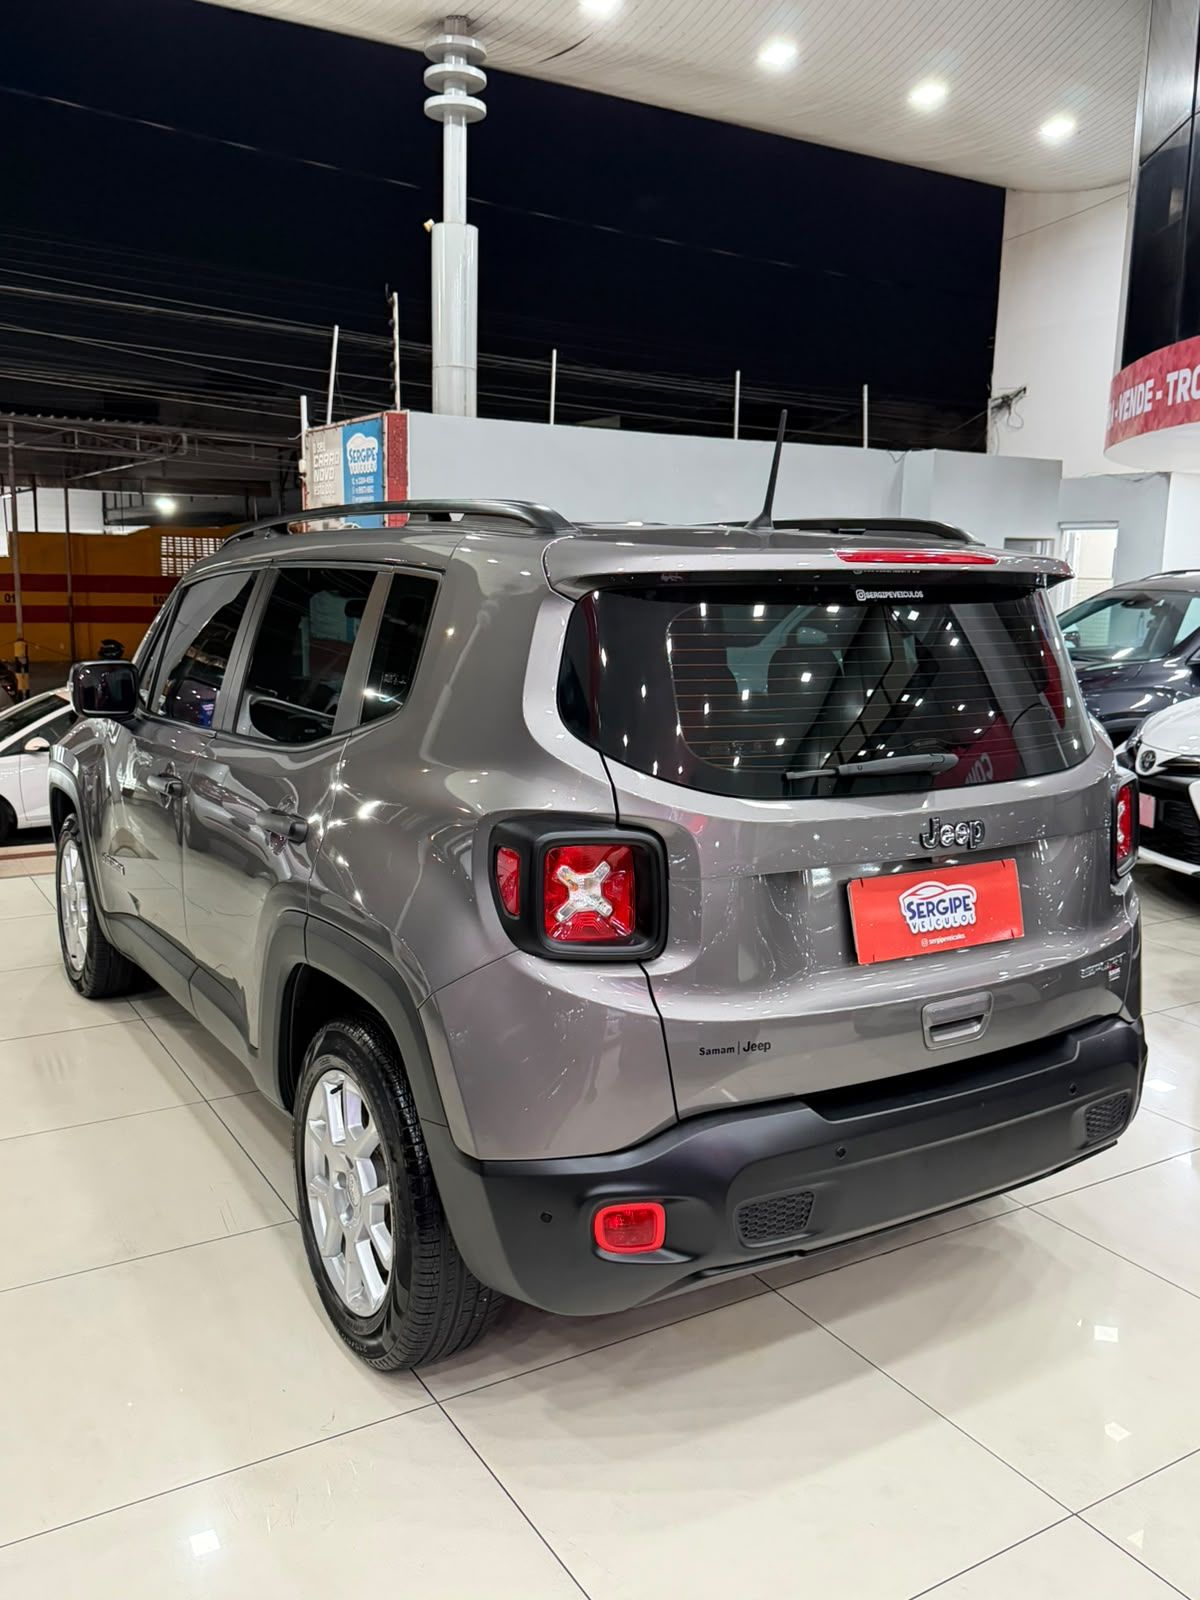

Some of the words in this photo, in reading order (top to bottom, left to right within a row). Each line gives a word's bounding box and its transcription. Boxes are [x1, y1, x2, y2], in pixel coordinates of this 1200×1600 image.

[1119, 378, 1155, 423] VENDE
[314, 449, 340, 468] CARRO
[314, 467, 335, 482] NOVO
[920, 817, 985, 850] Jeep
[906, 895, 972, 920] SERGIPE
[699, 1046, 735, 1056] Samam
[742, 1040, 771, 1053] Jeep
